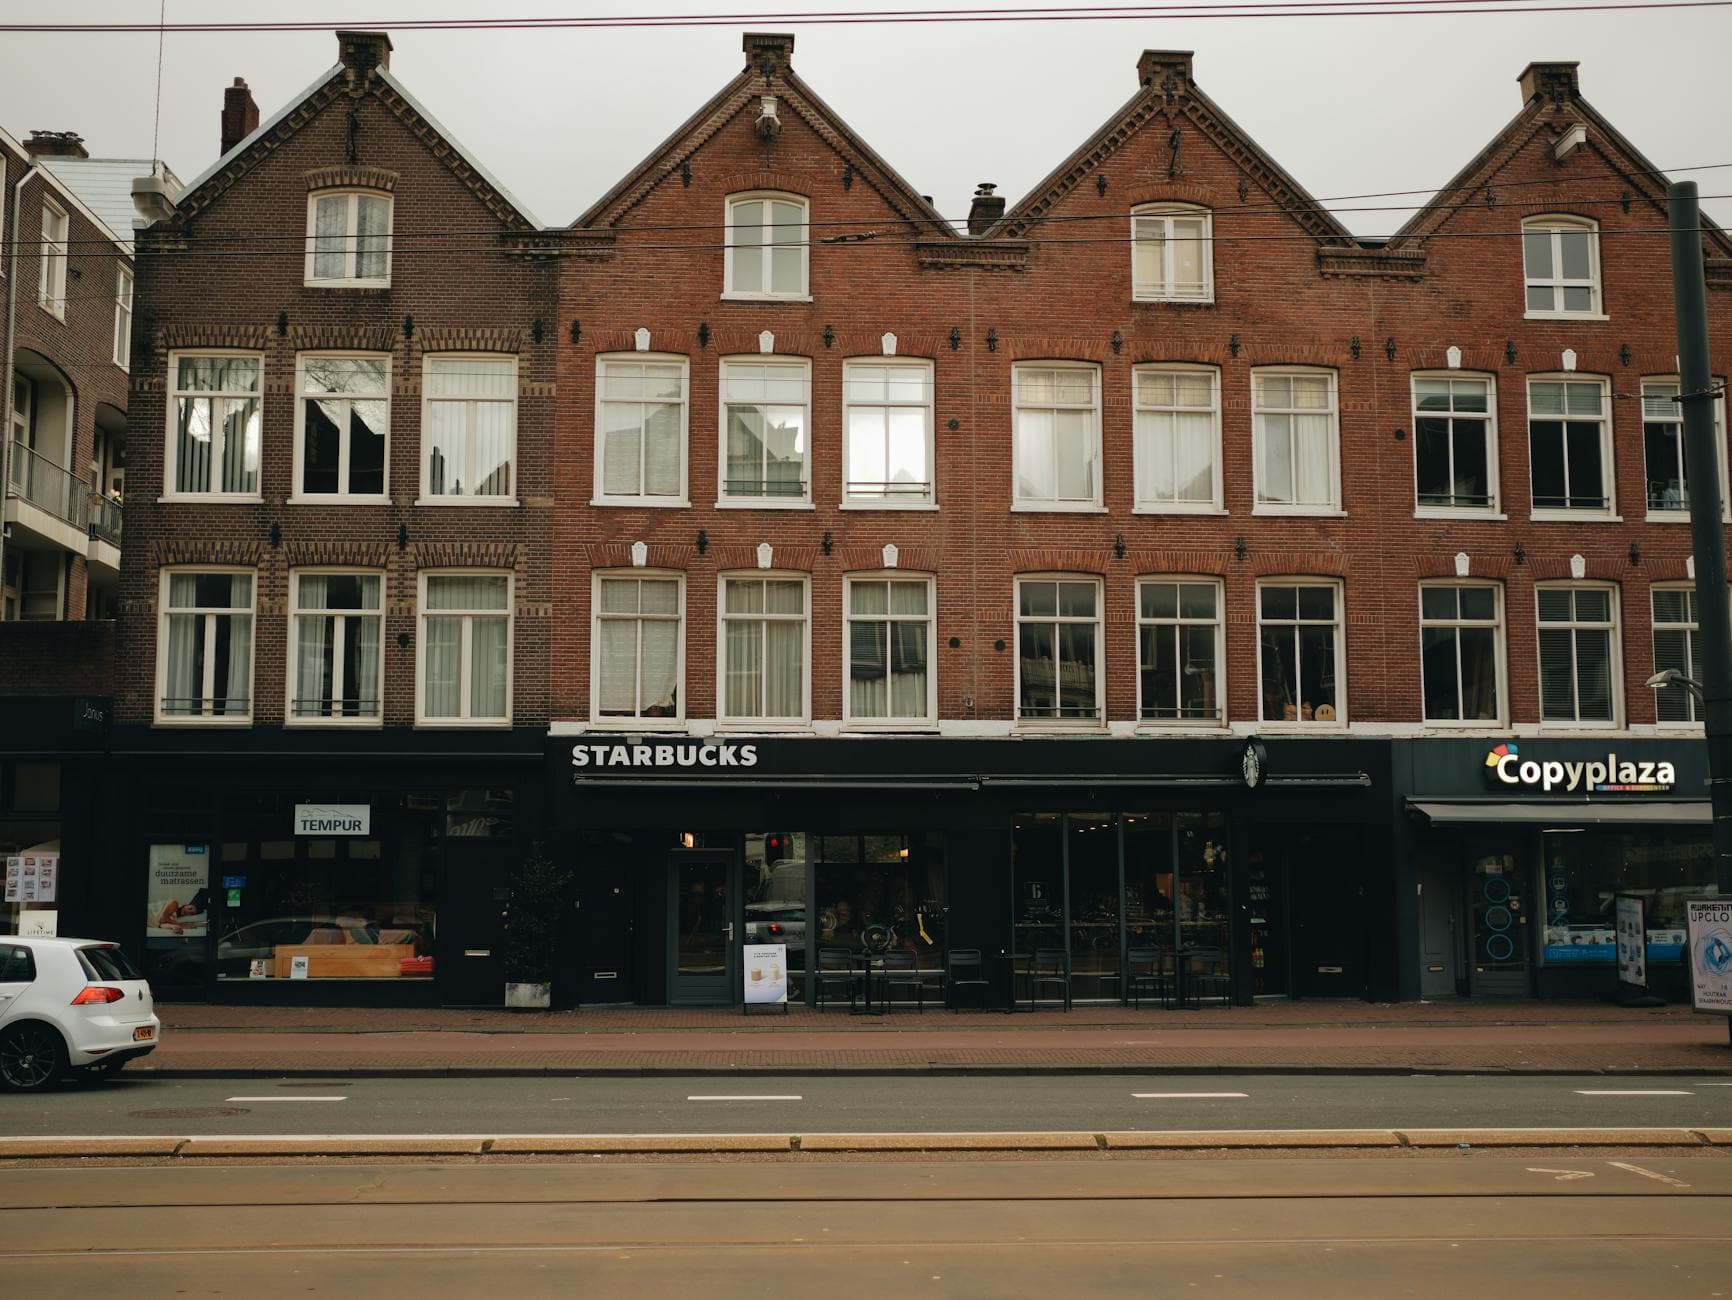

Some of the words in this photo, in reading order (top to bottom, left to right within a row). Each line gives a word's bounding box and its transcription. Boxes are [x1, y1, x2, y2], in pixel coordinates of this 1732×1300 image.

[572, 745, 757, 766] STARBUCKS
[1497, 753, 1675, 791] Copyplaza
[301, 820, 362, 831] TEMPUR
[155, 869, 197, 877] duurzame
[1691, 912, 1732, 922] UPCLO
